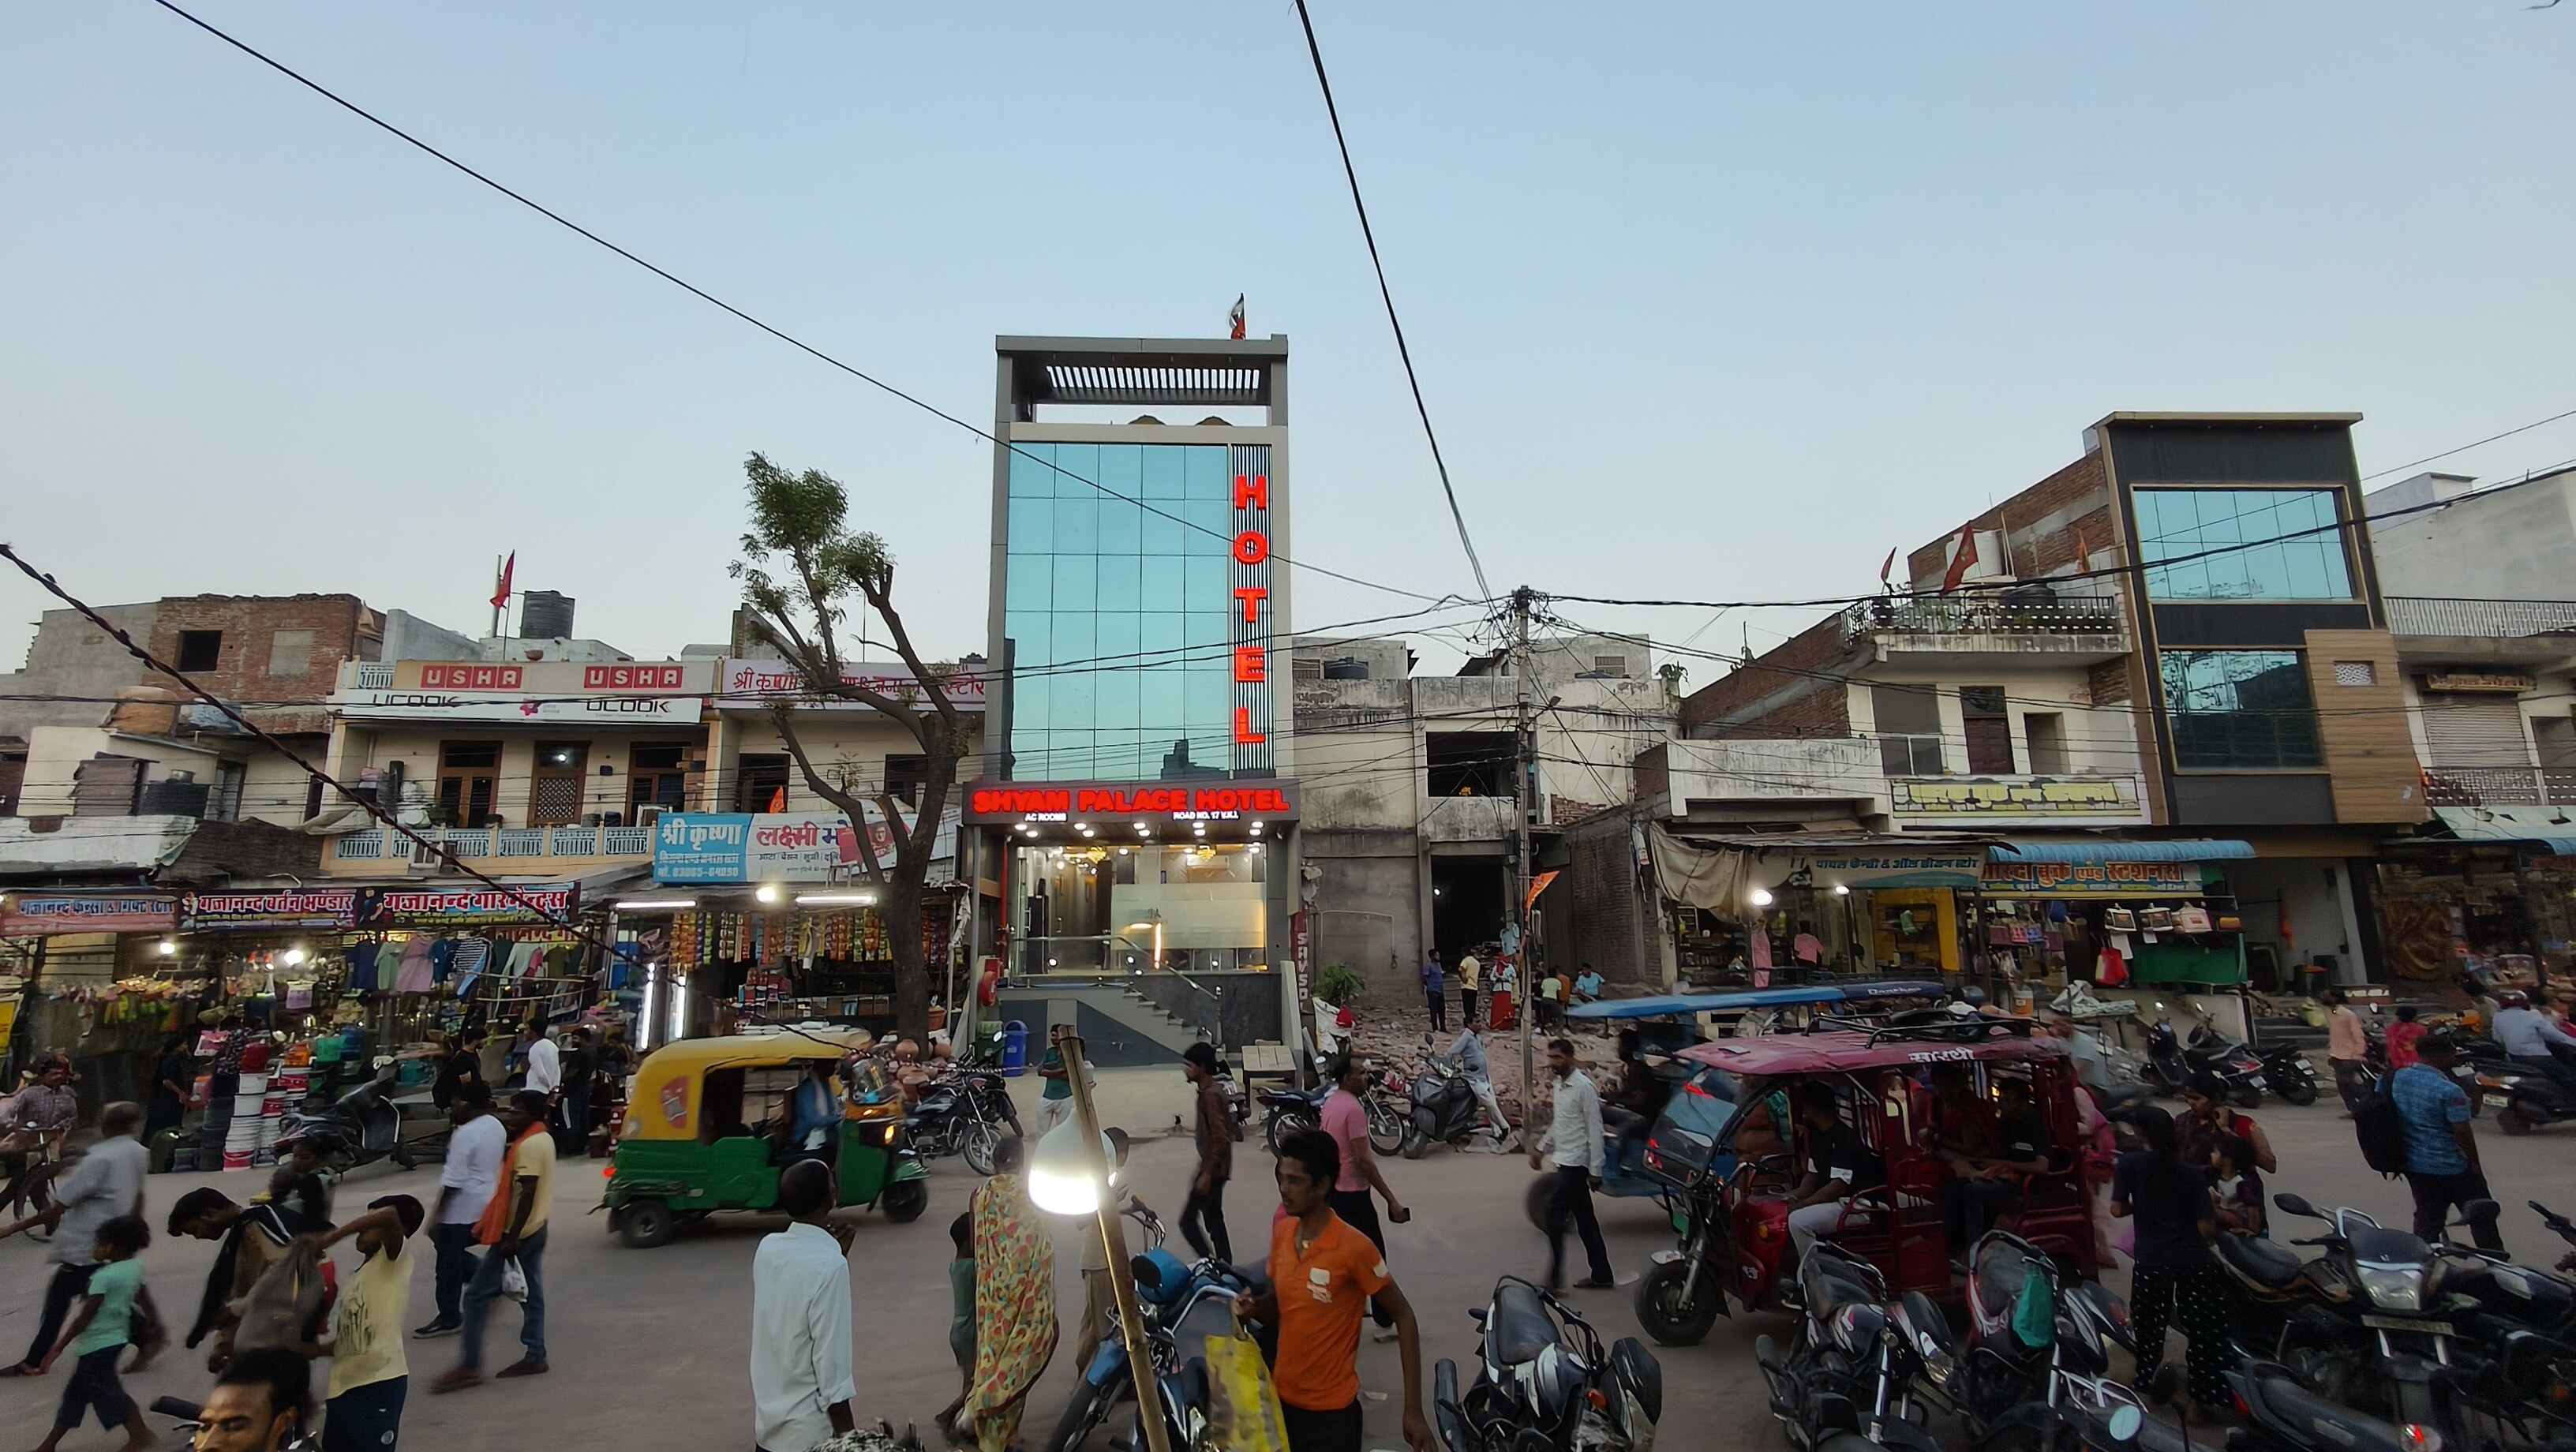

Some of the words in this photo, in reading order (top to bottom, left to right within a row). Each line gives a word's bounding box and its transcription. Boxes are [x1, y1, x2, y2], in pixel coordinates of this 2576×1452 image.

[1234, 474, 1267, 744] HOTEL
[425, 668, 519, 687] USHA
[589, 668, 679, 687] USHA
[733, 667, 754, 690] श्री
[972, 790, 1070, 813] SHYAM
[1078, 790, 1188, 813] PALACE
[1196, 789, 1290, 811] HOTEL
[1025, 813, 1037, 821] AC
[1038, 813, 1067, 821] ROOMS
[1173, 811, 1196, 820] ROAD
[661, 818, 687, 846] श्री
[689, 824, 743, 851] कृष्णा
[756, 820, 819, 850] लक्ष्मी
[199, 895, 264, 912] गजानन्द
[305, 893, 355, 911] भण्डार
[384, 892, 470, 911] गजानन्द
